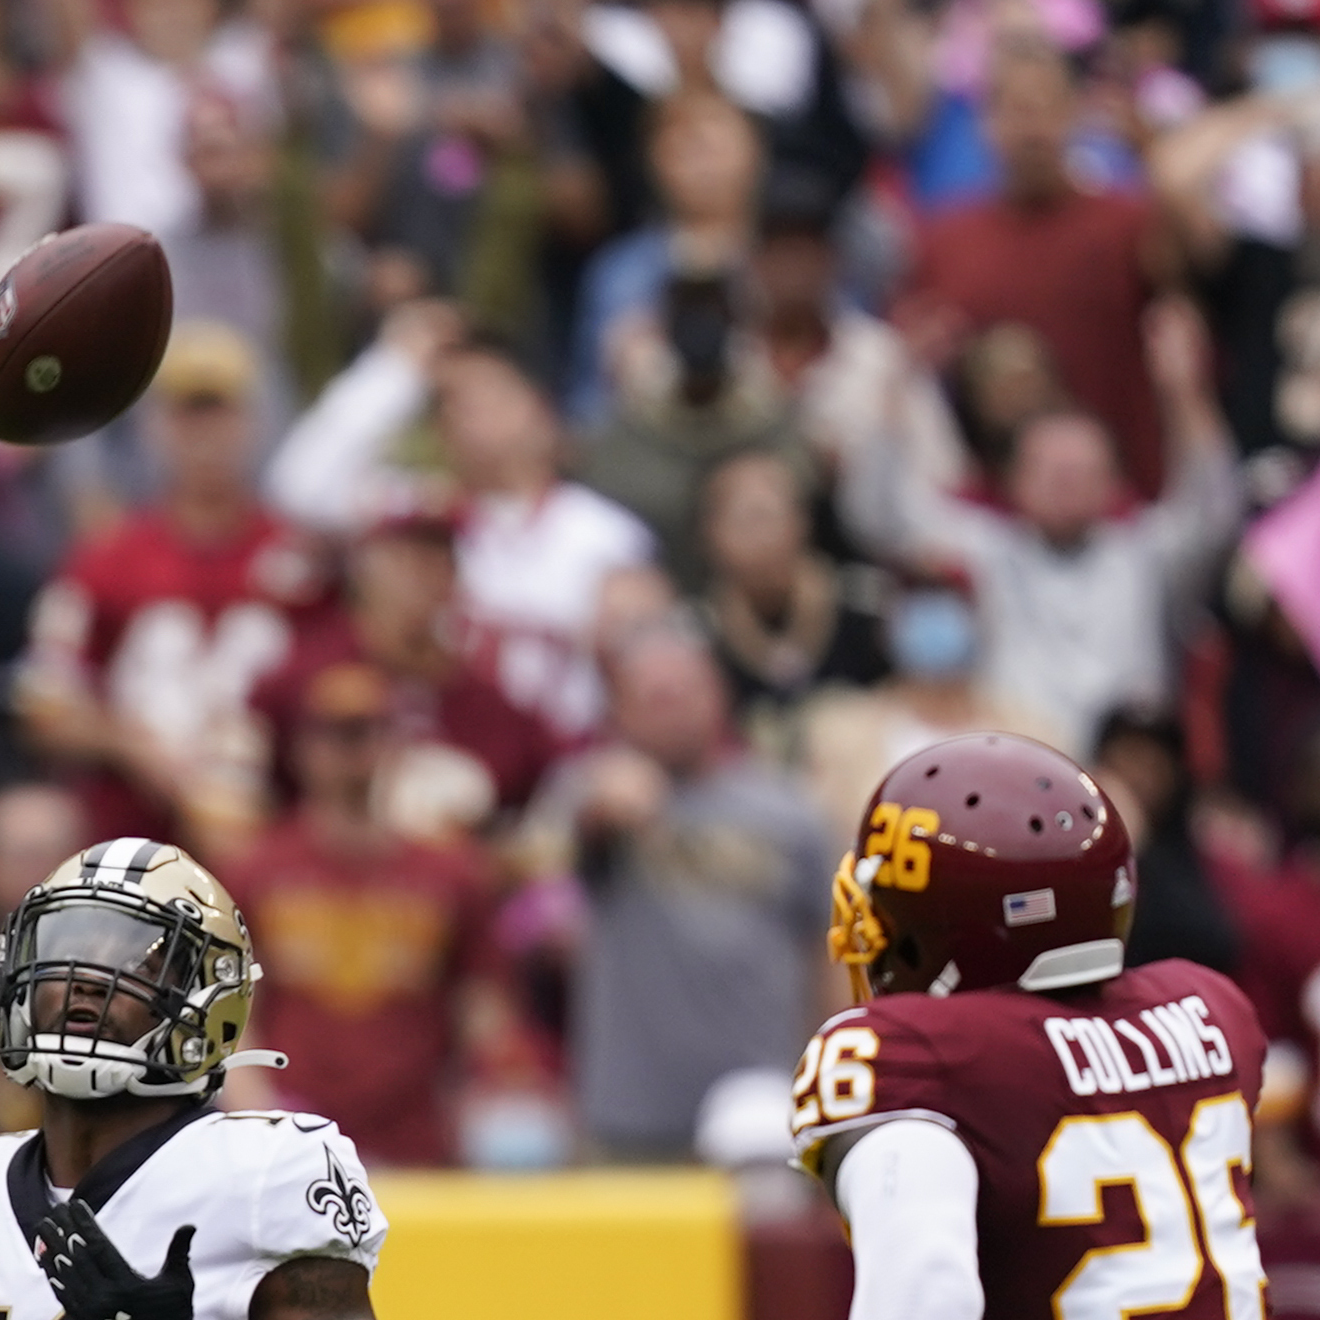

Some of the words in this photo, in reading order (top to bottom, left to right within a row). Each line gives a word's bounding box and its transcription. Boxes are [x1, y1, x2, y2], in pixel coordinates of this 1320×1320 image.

[867, 801, 940, 892] 26
[791, 1026, 880, 1135] 26
[1044, 995, 1233, 1096] COLLINS
